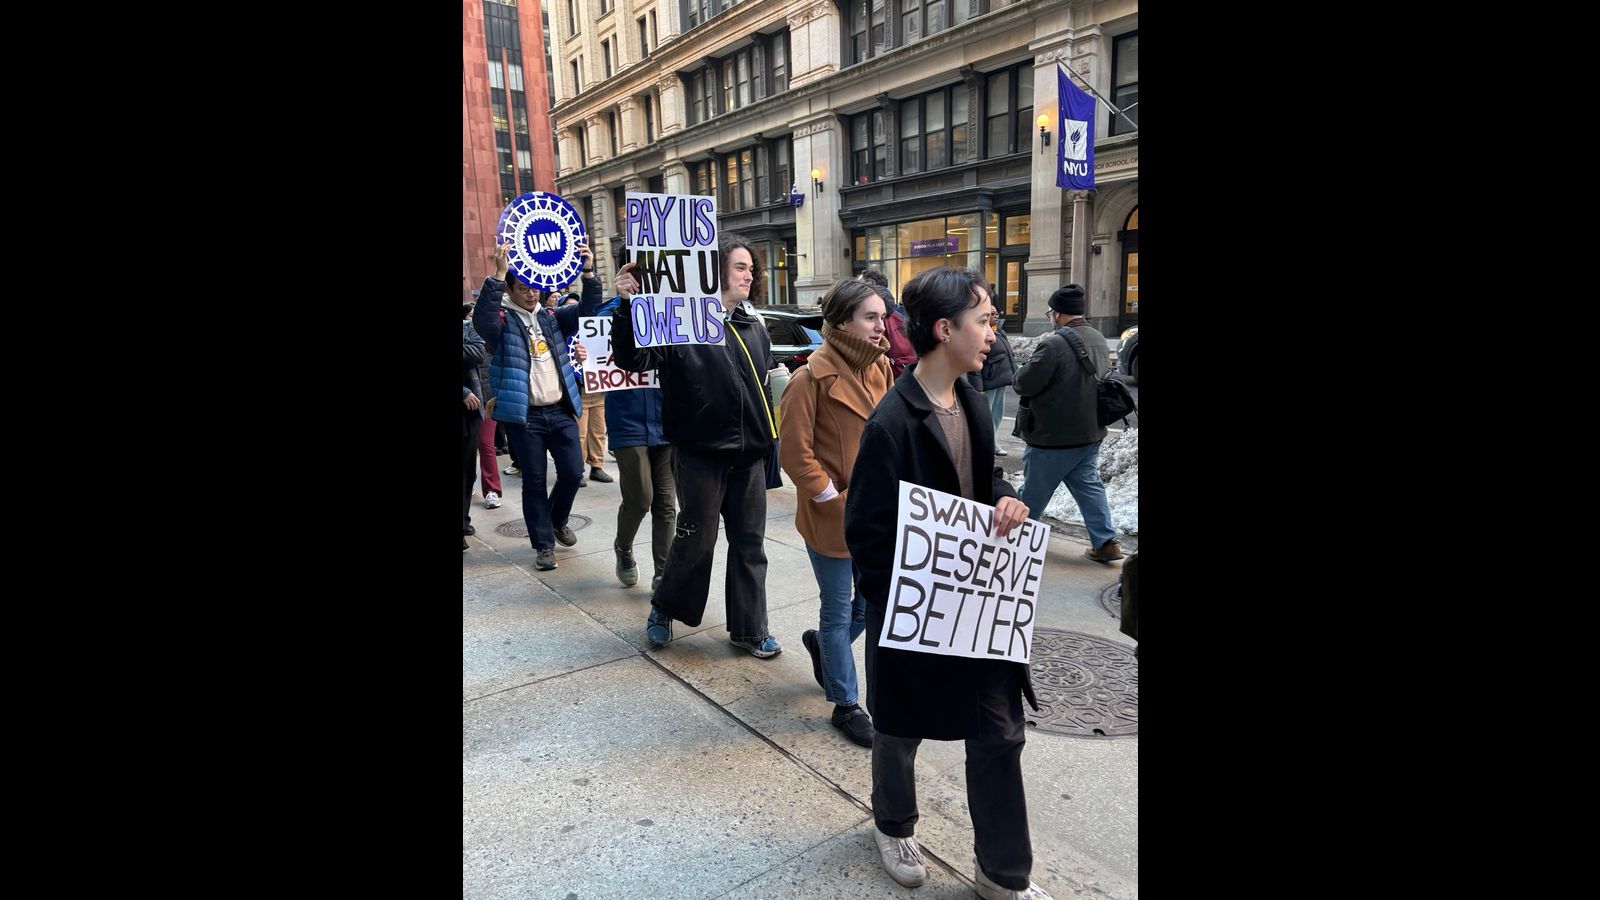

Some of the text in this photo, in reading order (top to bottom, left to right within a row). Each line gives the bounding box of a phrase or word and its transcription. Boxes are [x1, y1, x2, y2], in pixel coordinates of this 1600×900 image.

[1064, 161, 1088, 177] NYU
[1105, 158, 1129, 168] SCHOOL
[527, 231, 561, 254] UAW
[626, 197, 676, 247] PAY
[679, 198, 715, 247] US
[697, 250, 719, 295] U
[631, 297, 724, 346] OWE US
[585, 369, 649, 391] BROKE
[908, 487, 993, 538] SWAN
[900, 524, 1043, 597] DESERVE
[886, 576, 1034, 659] BETTER
